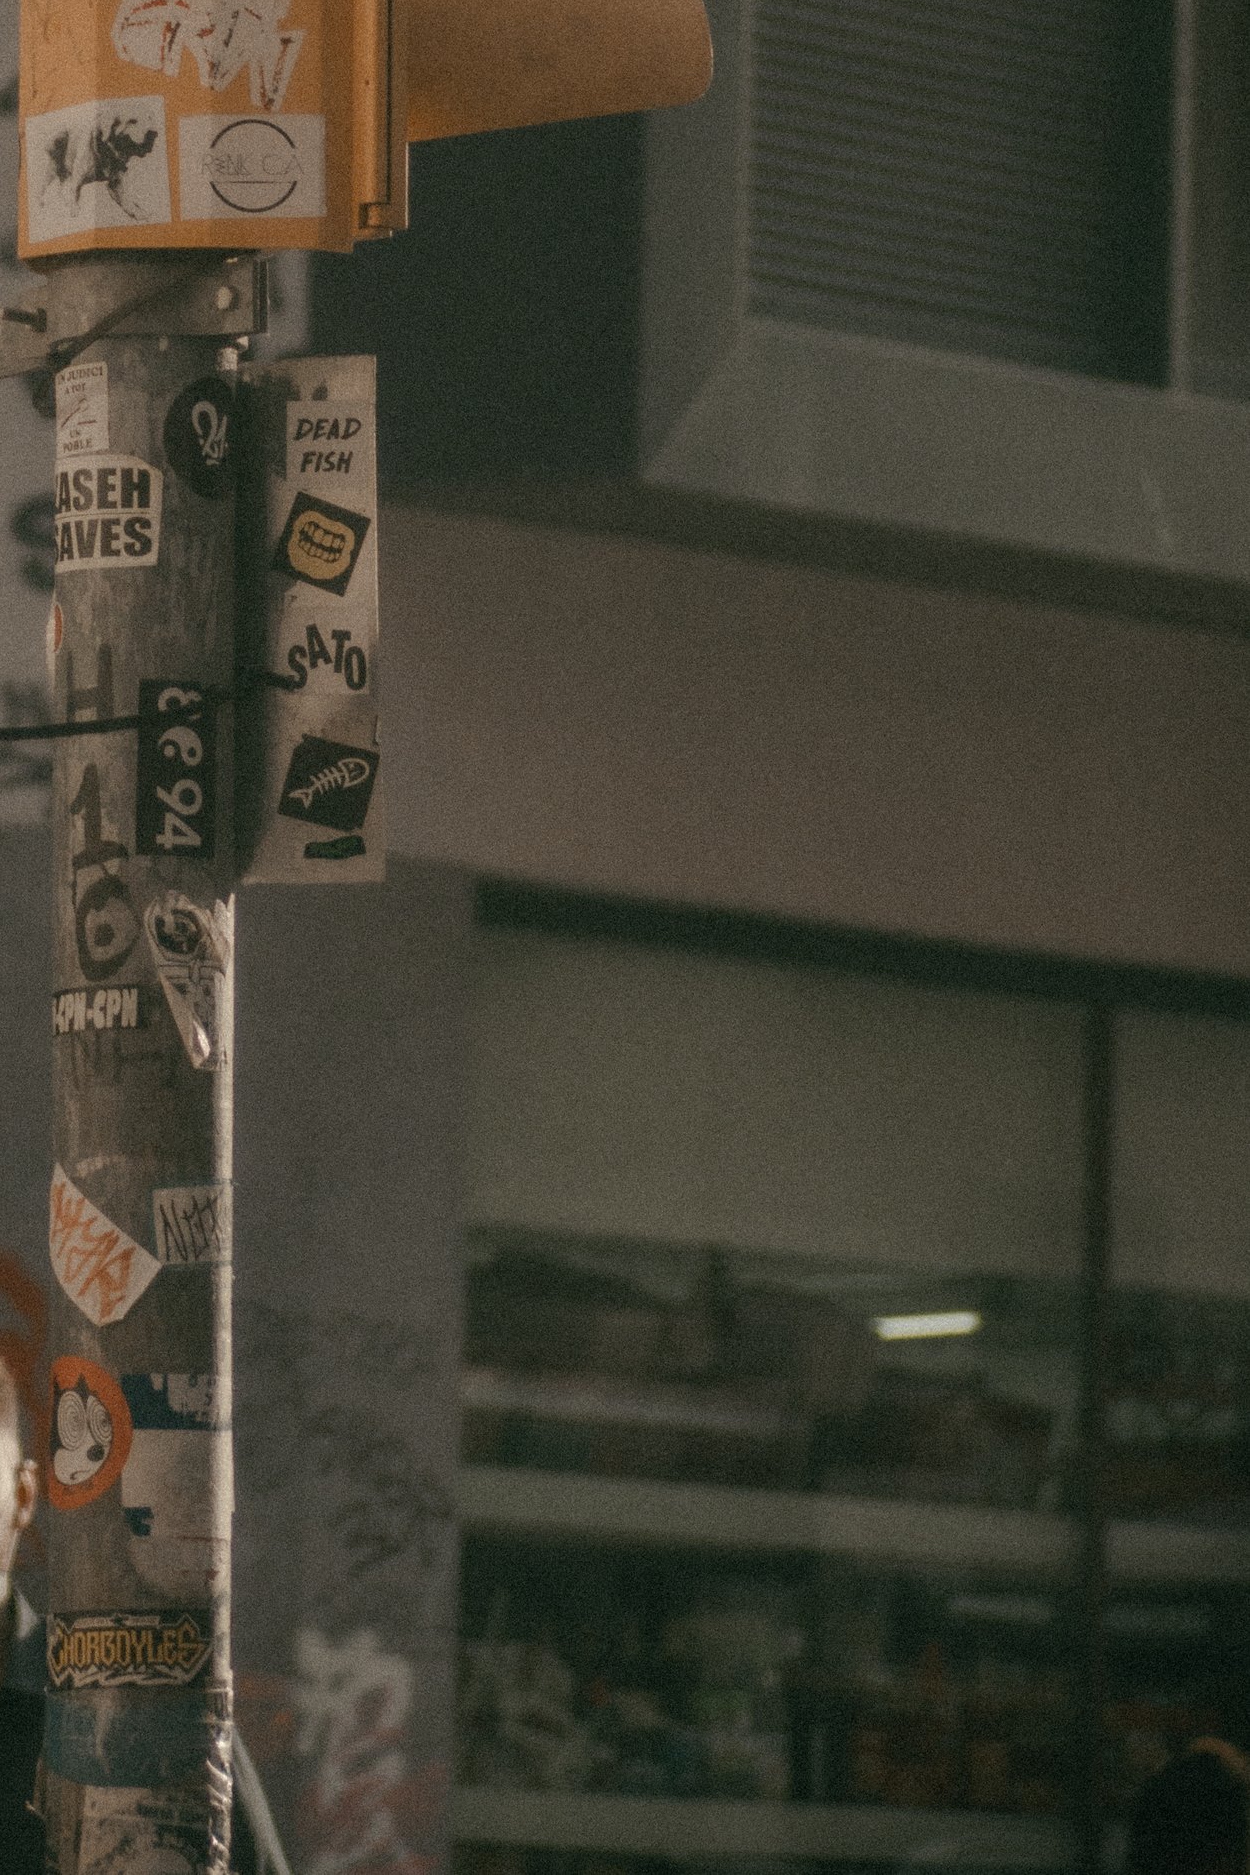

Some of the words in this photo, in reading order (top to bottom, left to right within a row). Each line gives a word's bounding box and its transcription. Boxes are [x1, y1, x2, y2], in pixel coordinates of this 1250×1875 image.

[293, 417, 362, 441] DEAD
[300, 451, 354, 474] FISH
[55, 468, 150, 513] ASEH
[287, 622, 366, 691] SATO
